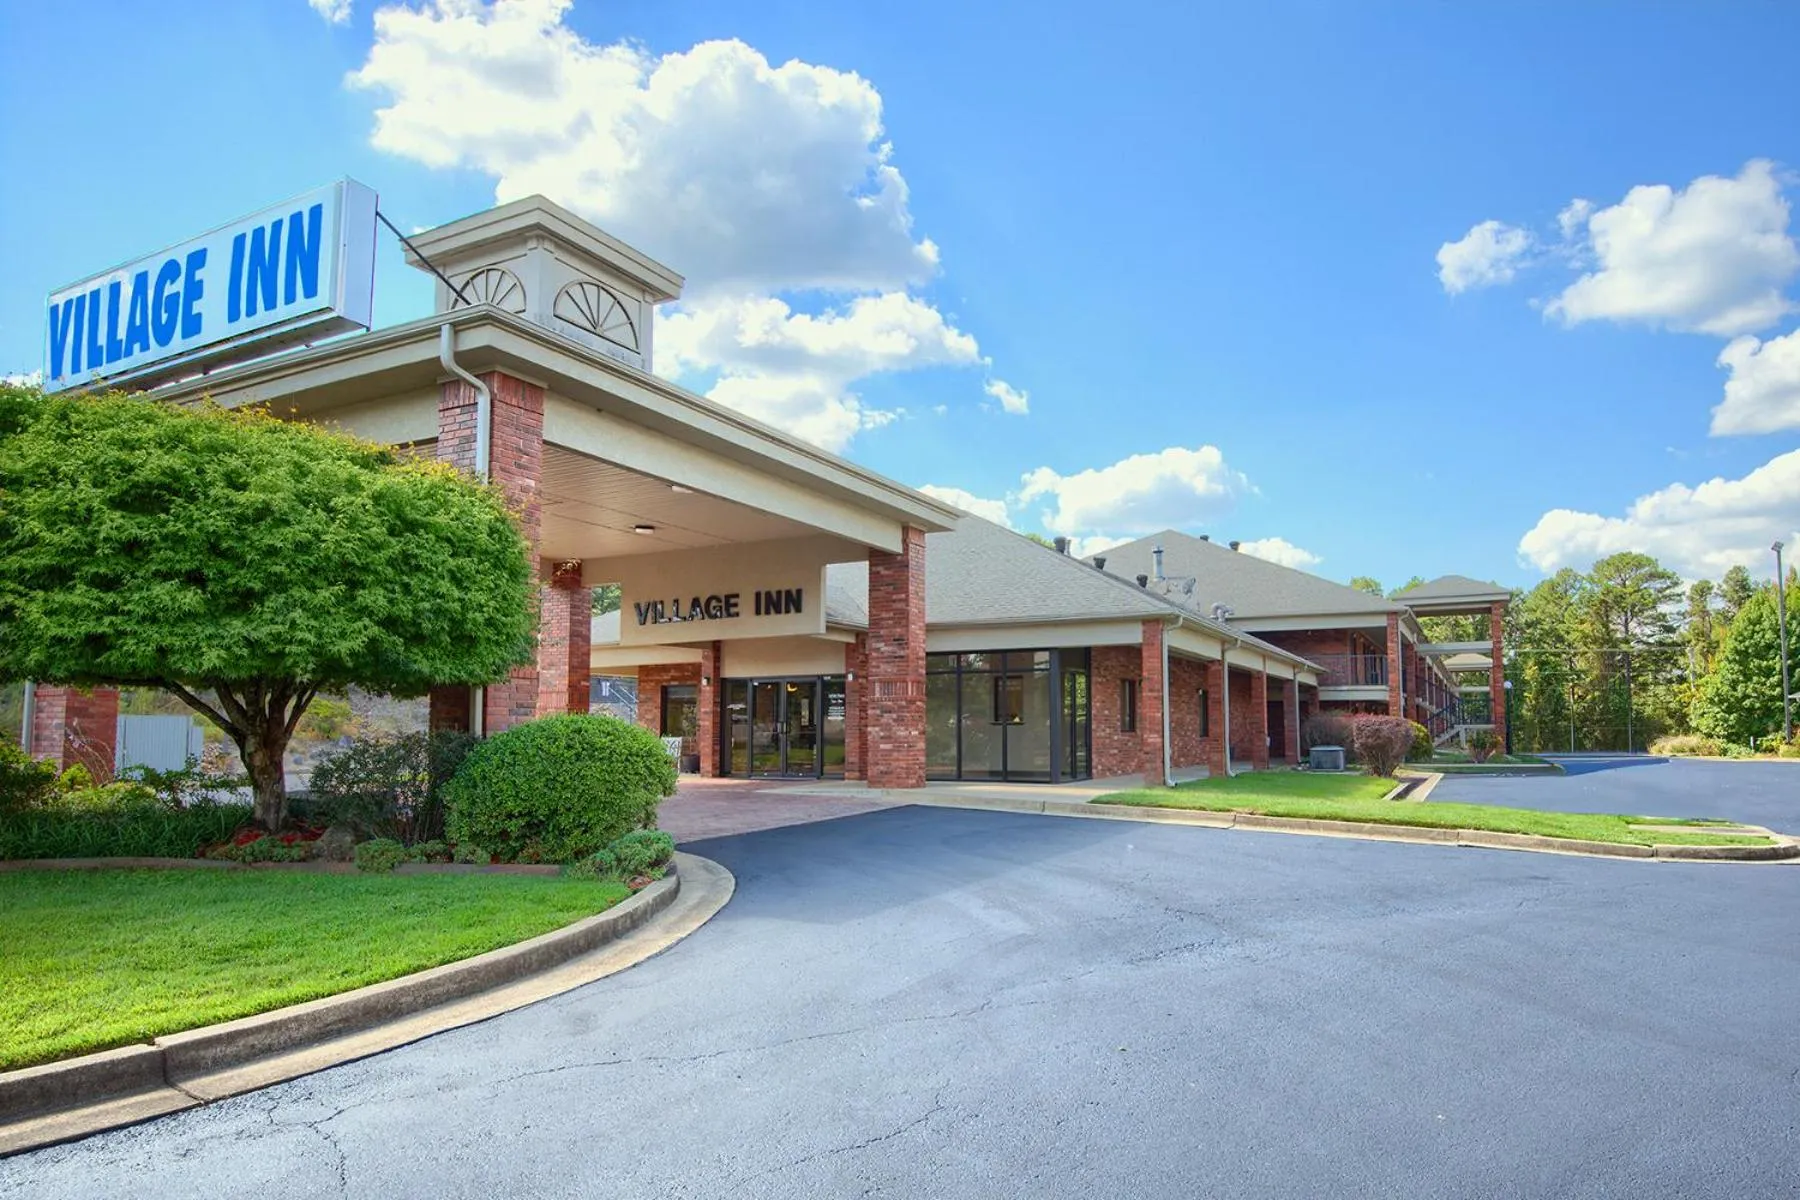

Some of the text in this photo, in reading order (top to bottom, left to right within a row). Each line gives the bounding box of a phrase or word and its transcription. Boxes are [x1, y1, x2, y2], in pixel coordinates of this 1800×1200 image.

[50, 203, 322, 381] VILLAGE INN
[634, 588, 803, 626] VILLAGE INN
